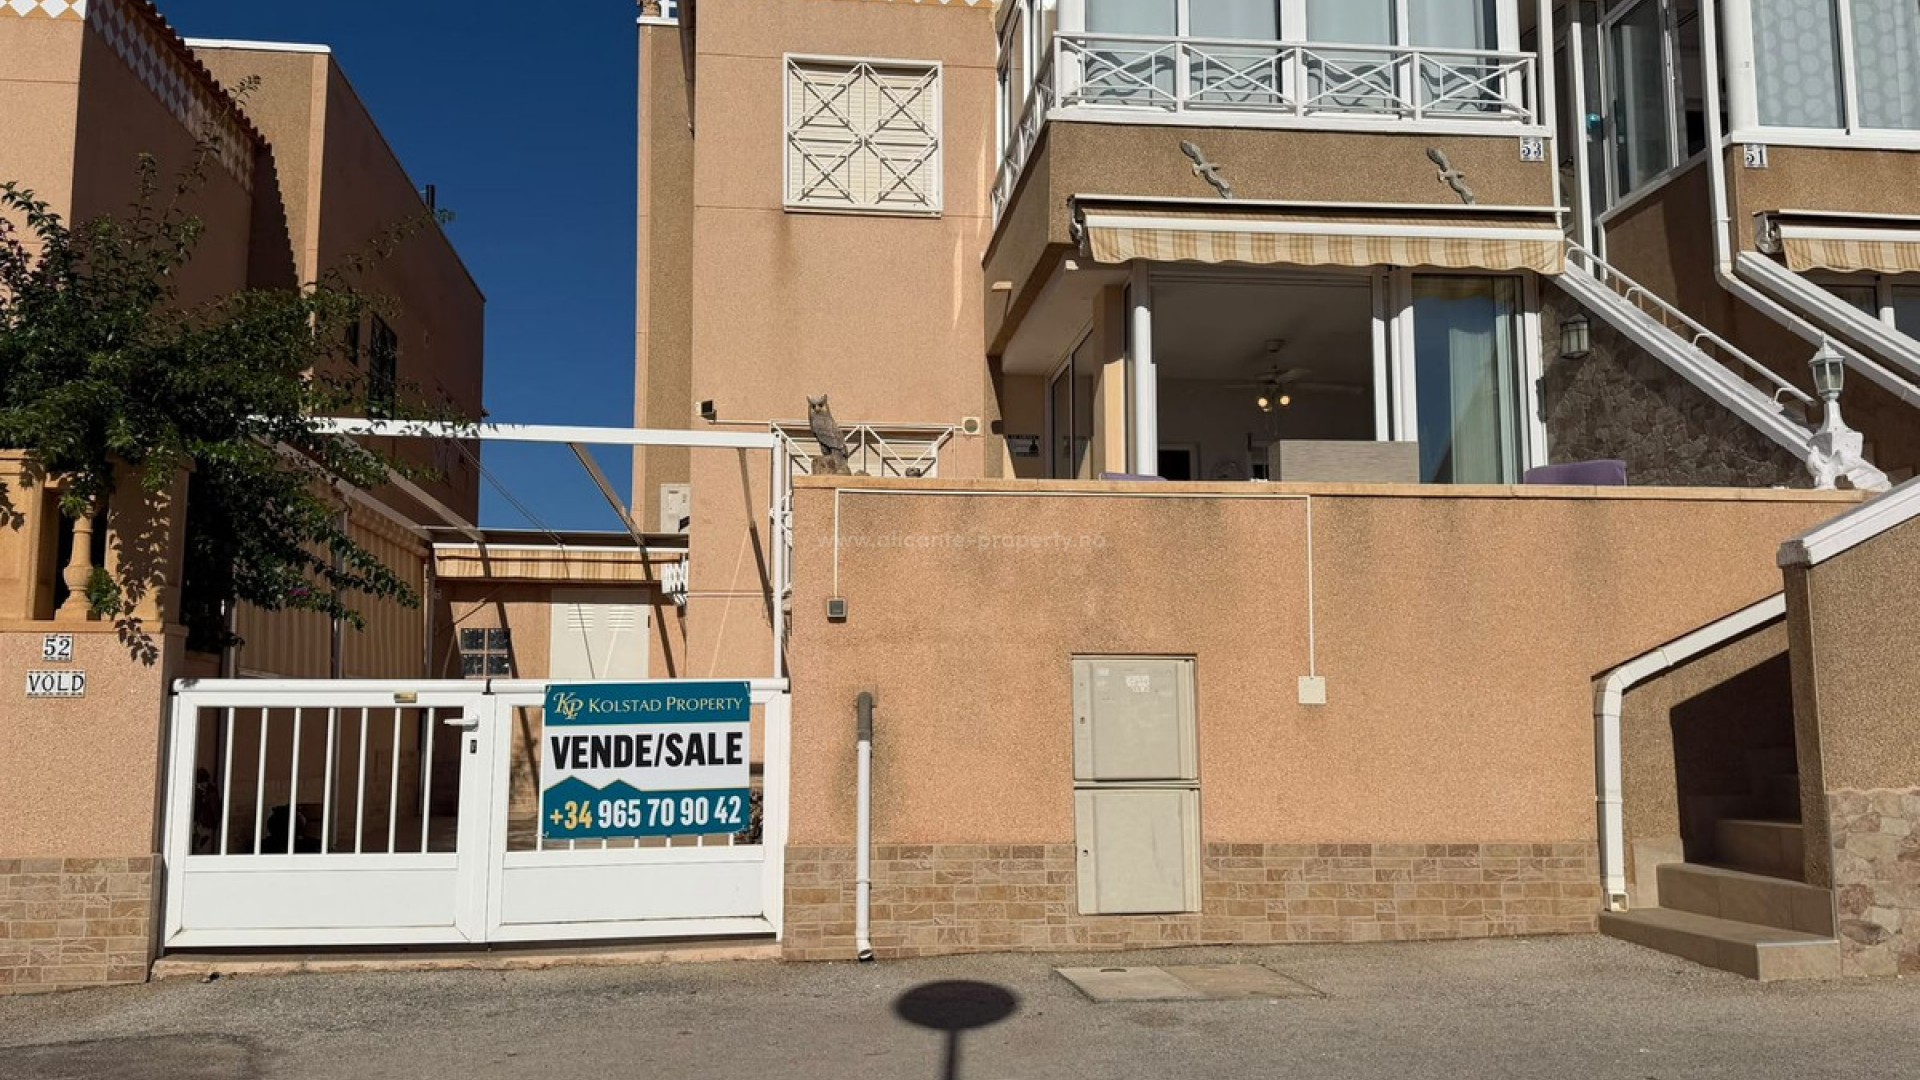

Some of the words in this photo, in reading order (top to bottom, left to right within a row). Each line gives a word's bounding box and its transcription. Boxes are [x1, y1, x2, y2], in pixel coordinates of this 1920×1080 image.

[1522, 139, 1542, 157] 53
[1746, 148, 1764, 165] 51
[44, 638, 70, 656] 52
[28, 674, 84, 692] VOLD
[588, 698, 662, 713] KOLSTAD
[666, 696, 743, 711] PROPERTY
[551, 732, 743, 769] VENDE/SALE
[550, 800, 593, 830] +34
[598, 798, 641, 829] 965
[647, 797, 675, 827] 70
[680, 796, 709, 826] 90
[714, 795, 742, 824] 42
